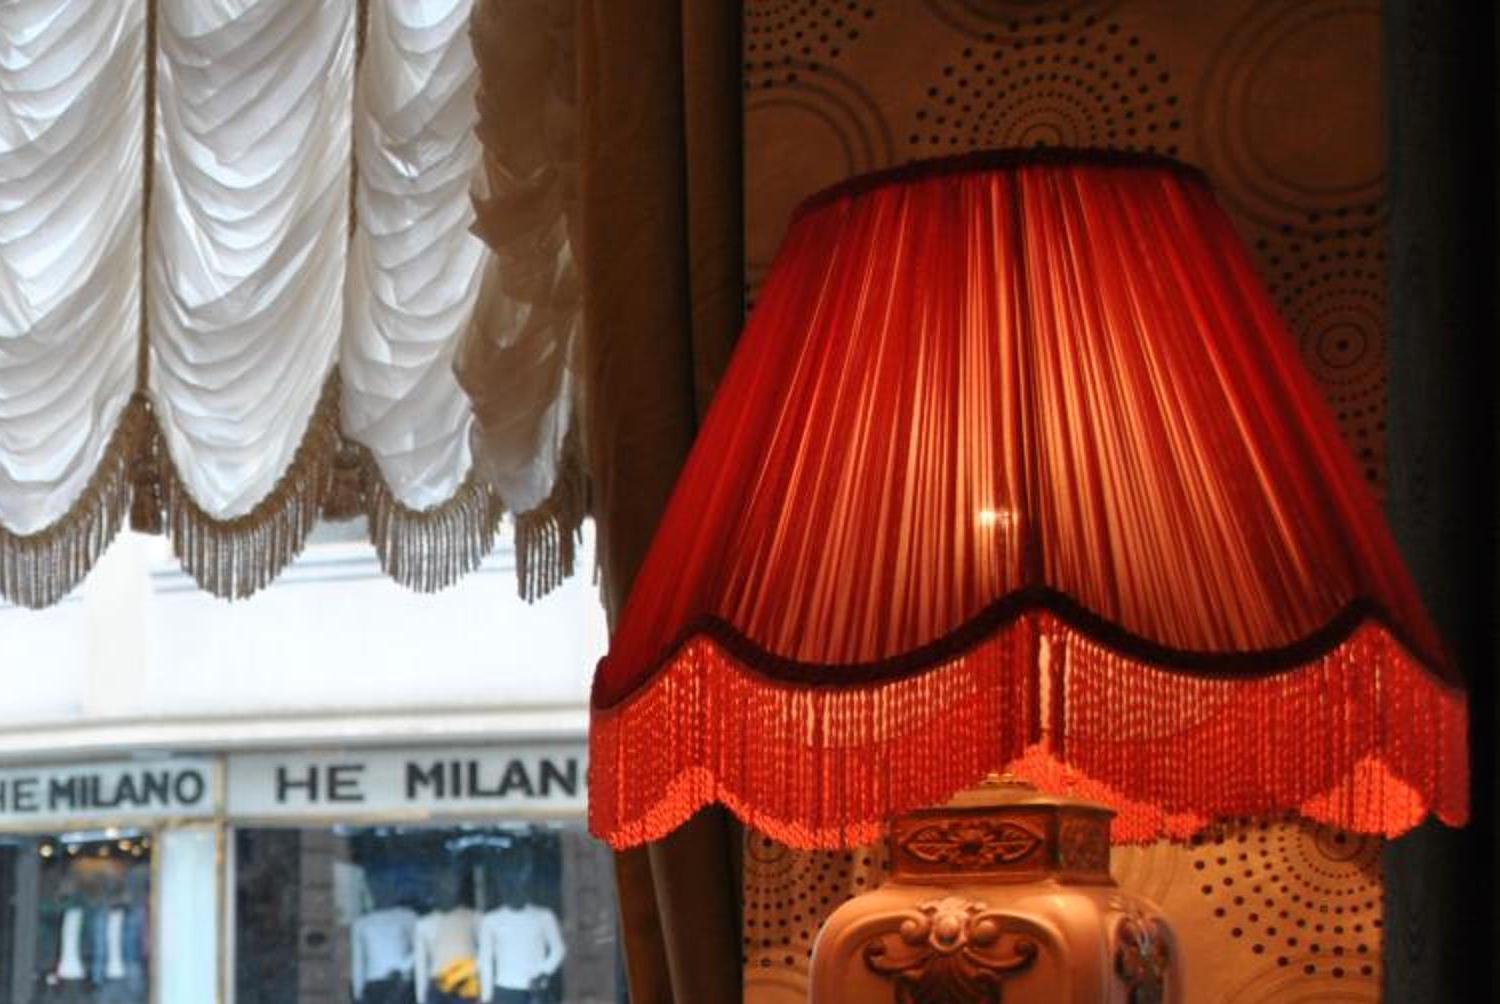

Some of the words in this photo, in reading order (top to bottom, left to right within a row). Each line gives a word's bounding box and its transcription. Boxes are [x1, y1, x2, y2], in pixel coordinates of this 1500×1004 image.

[50, 769, 204, 812] MILANO
[276, 764, 365, 803] HE
[405, 757, 588, 799] MILAN
